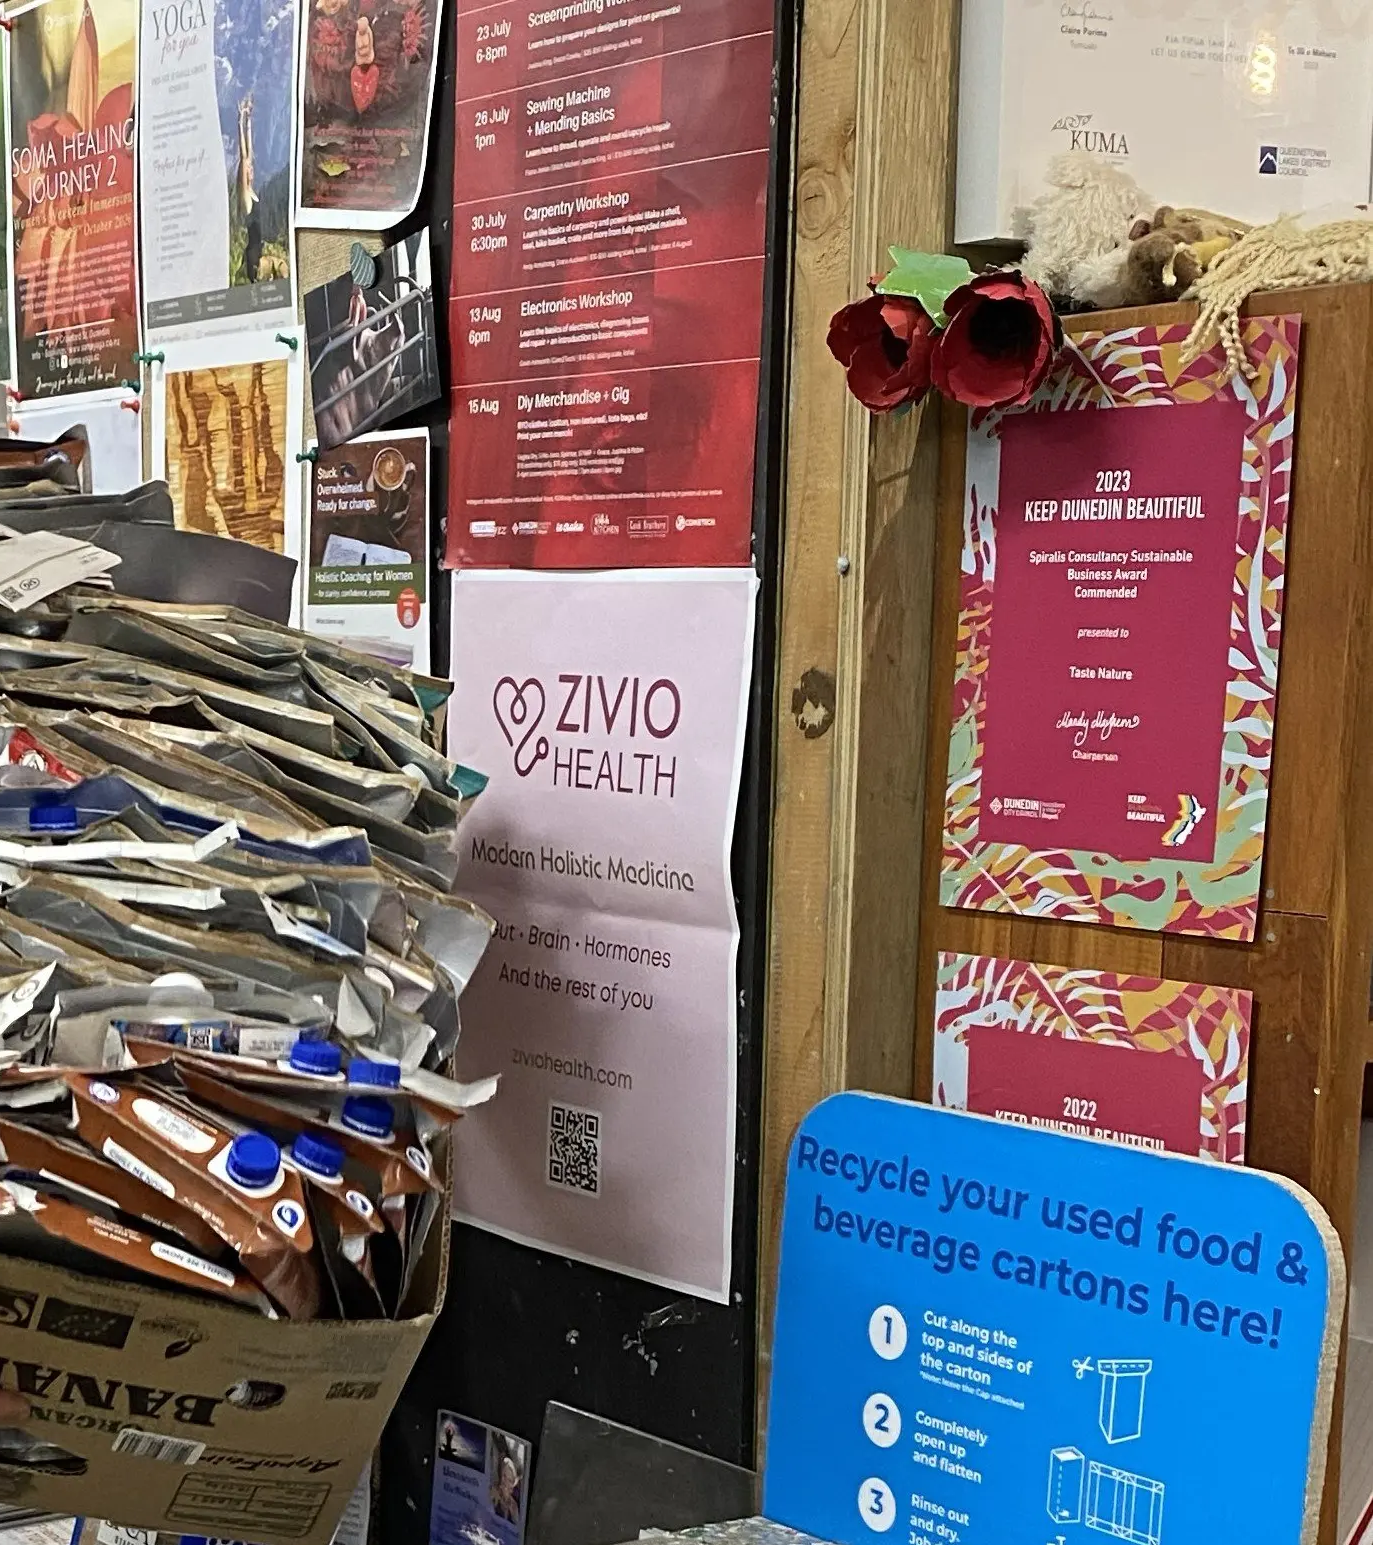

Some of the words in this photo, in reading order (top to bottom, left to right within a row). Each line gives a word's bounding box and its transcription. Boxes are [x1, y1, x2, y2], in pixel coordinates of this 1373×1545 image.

[153, 0, 207, 40] YOGA
[528, 0, 604, 27] Screenprinting
[477, 25, 490, 42] 23
[491, 19, 512, 38] July
[476, 45, 508, 63] 6-8pm
[527, 96, 564, 115] Sewing
[566, 85, 611, 107] Machine
[475, 111, 488, 127] 26
[489, 106, 510, 124] July
[527, 125, 533, 136] +
[535, 115, 579, 136] Mending
[582, 107, 615, 126] Basics
[12, 141, 57, 178] SOMA
[63, 118, 134, 163] HEALING
[475, 133, 496, 151] 1pm
[1070, 130, 1129, 154] KUMA
[28, 161, 102, 214] JOURNEY
[107, 155, 118, 186] 2
[523, 199, 574, 221] Carpentry
[575, 191, 630, 212] Workshop
[471, 215, 484, 230] 30
[486, 211, 507, 229] July
[470, 235, 508, 252] 6:30pm
[469, 308, 480, 322] 13
[481, 307, 502, 323] Aug
[520, 297, 577, 317] Electronics
[579, 289, 633, 308] Workshop
[468, 330, 490, 346] 6pm
[468, 399, 479, 414] 15
[479, 400, 500, 415] Aug
[517, 394, 534, 412] Diy
[534, 389, 601, 408] Merchandise
[611, 386, 630, 405] Gig
[1095, 470, 1131, 493] 2023
[317, 500, 337, 513] Ready
[338, 499, 347, 511] for
[349, 498, 377, 512] change.
[1024, 500, 1058, 522] KEEP
[1061, 499, 1122, 521] DUNEDIN
[1126, 496, 1205, 520] BEAUTIFUL
[1029, 551, 1066, 565] Spiralis
[1068, 550, 1128, 564] Consultancy
[1130, 550, 1193, 563] Sustainable
[315, 572, 339, 583] Holistic
[340, 571, 371, 584] Coaching
[373, 571, 383, 582] for
[385, 570, 413, 582] Women
[1067, 568, 1112, 581] Business
[1114, 568, 1147, 581] Award
[1075, 585, 1138, 598] Commended
[1077, 628, 1119, 639] presented
[1120, 628, 1129, 638] to
[1069, 666, 1096, 679] Taste
[1097, 667, 1133, 680] Nature
[556, 674, 681, 738] ZIVIO
[1072, 750, 1118, 761] Chairperson
[553, 746, 676, 798] HEALTH
[1003, 798, 1039, 811] DUNEDIN
[471, 838, 535, 870] Modern
[541, 846, 602, 879] Holistic
[607, 857, 694, 892] Medicine
[528, 926, 570, 951] Brain
[585, 935, 671, 968] Hormones
[499, 962, 529, 986] And
[534, 969, 562, 993] the
[565, 978, 596, 1000] rest
[600, 982, 619, 1004] of
[621, 991, 654, 1010] you
[512, 1048, 633, 1090] ziviohealth.com
[1063, 1096, 1097, 1122] 2022
[797, 1134, 930, 1197] Recycle
[938, 1173, 1029, 1220] your
[1041, 1196, 1144, 1248] used
[1156, 1212, 1263, 1275] food
[1276, 1241, 1309, 1286] &
[814, 1193, 981, 1275] beverage
[991, 1249, 1150, 1316] cartons
[1163, 1280, 1282, 1350] here!
[883, 1316, 892, 1344] 1
[923, 1310, 948, 1329] Cut
[950, 1319, 990, 1344] along
[993, 1330, 1018, 1348] the
[921, 1331, 945, 1352] top
[947, 1340, 975, 1358] and
[977, 1347, 1014, 1370] sides
[1016, 1360, 1034, 1375] of
[920, 1352, 943, 1371] the
[946, 1362, 991, 1385] carton
[942, 1377, 961, 1391] leave
[961, 1384, 975, 1395] the
[975, 1388, 991, 1400] Cap
[991, 1393, 1025, 1410] attached
[874, 1403, 889, 1433] 2
[915, 1410, 988, 1447] Completely
[914, 1432, 946, 1452] open
[948, 1443, 966, 1459] up
[912, 1450, 937, 1467] and
[939, 1457, 982, 1484] flatten
[869, 1488, 883, 1515] 3
[911, 1493, 945, 1517] Rinse
[947, 1508, 970, 1526] out
[908, 1531, 931, 1545] Job
[910, 1515, 933, 1532] and
[936, 1523, 961, 1543] dry.
